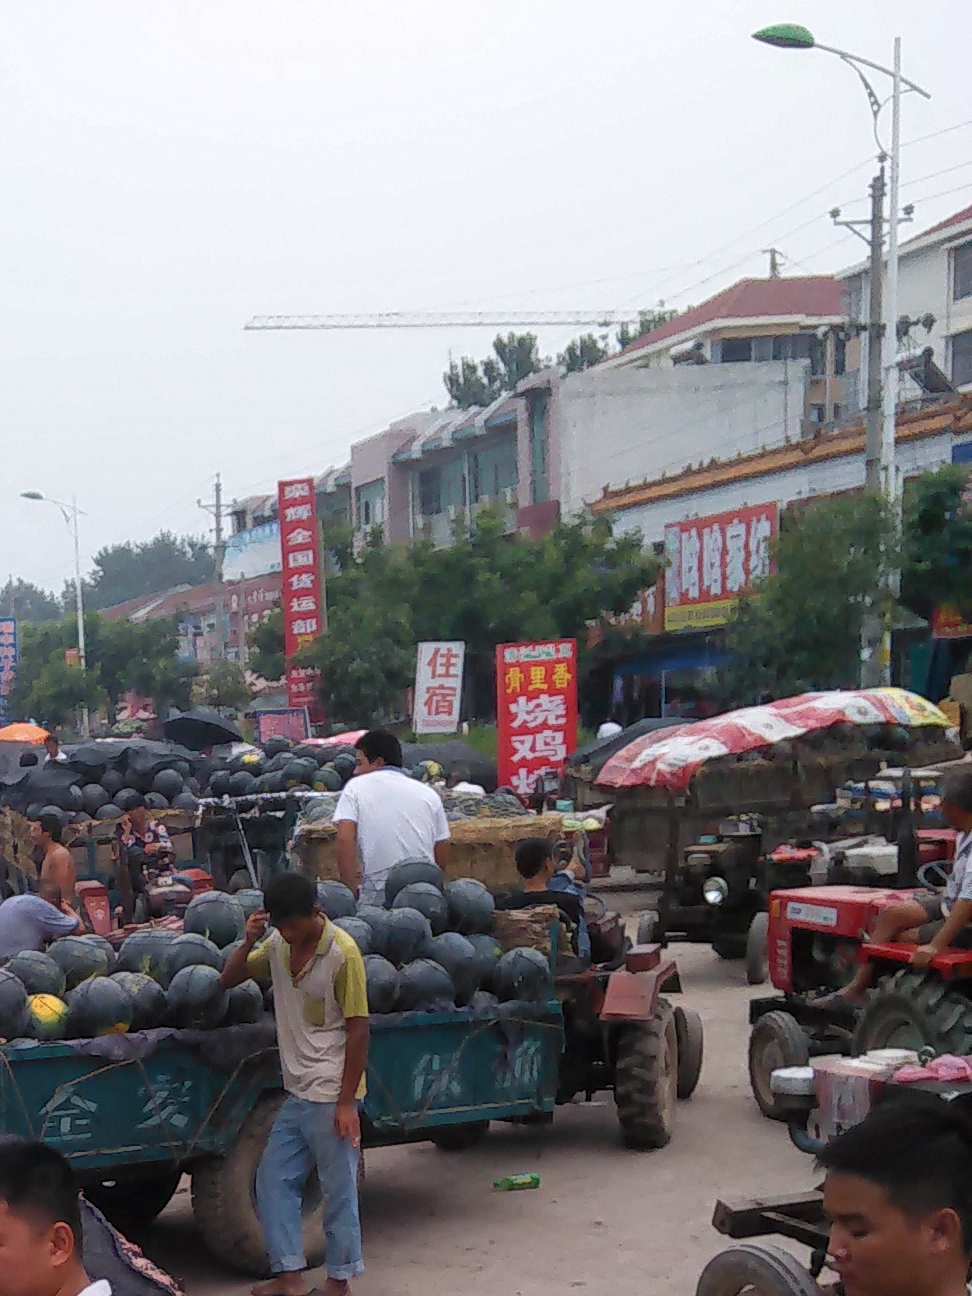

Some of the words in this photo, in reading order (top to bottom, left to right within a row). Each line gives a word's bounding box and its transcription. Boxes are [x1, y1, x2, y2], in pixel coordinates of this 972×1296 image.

[423, 647, 460, 717] 住宿
[504, 662, 573, 695] 骨里香
